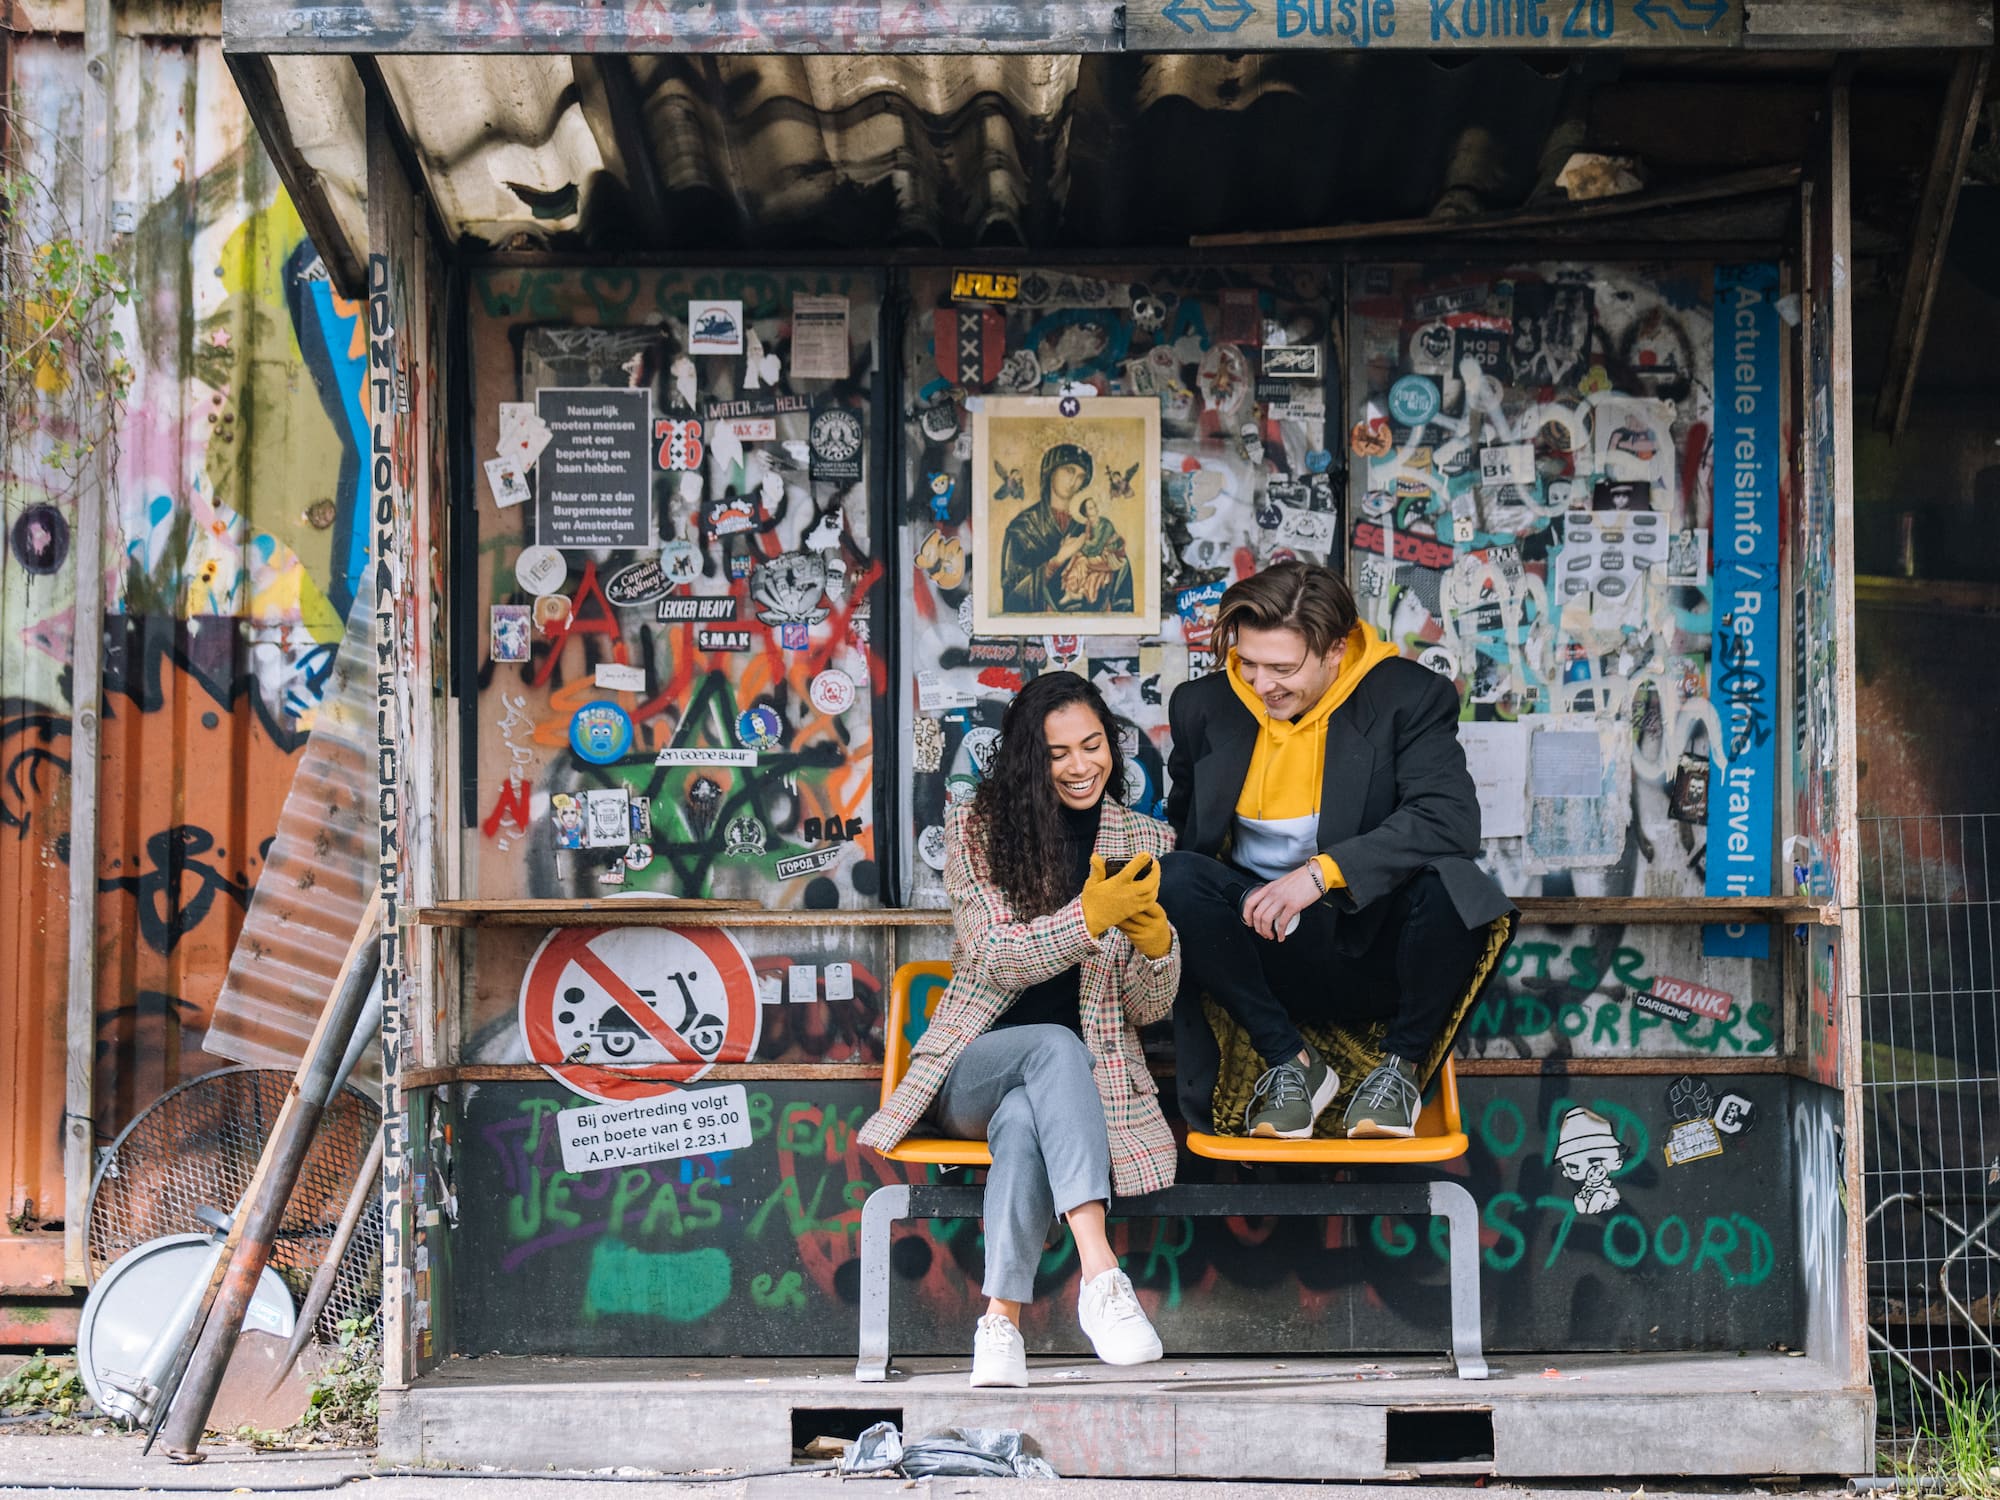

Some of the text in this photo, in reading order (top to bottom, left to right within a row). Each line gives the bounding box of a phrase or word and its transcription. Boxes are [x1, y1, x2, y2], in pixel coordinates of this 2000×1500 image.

[1734, 286, 1762, 415] Actuele
[567, 405, 619, 418] Natuurlijk
[709, 400, 751, 418] MATCH
[775, 396, 807, 412] HELL
[551, 420, 635, 430] moeten mensen
[571, 435, 614, 444] met een
[555, 448, 631, 460] beperking een
[556, 462, 627, 473] baan hebben.
[551, 490, 635, 501] Maar om ze dan
[1734, 426, 1763, 556] reisinfo
[553, 505, 633, 518] Burgermeester
[551, 520, 634, 530] van Amsterdam
[562, 534, 574, 543] te
[620, 561, 658, 588] Captain
[623, 570, 666, 599] Rodney's
[658, 599, 735, 618] LEKKER HEAVY
[700, 632, 750, 647] SMAK
[1732, 590, 1762, 667] Real
[1727, 767, 1755, 862] travel
[780, 858, 814, 875] ГОРОД
[1725, 875, 1754, 938] ino
[1636, 995, 1691, 1021] CARBONE
[1655, 980, 1726, 1016] VRANK.
[577, 1094, 729, 1129] Bij overtreding volgt
[571, 1111, 740, 1147] een boete van € 95.00
[588, 1131, 728, 1164] A.P.V-artikel 2.23.1
[510, 1165, 582, 1238] JE
